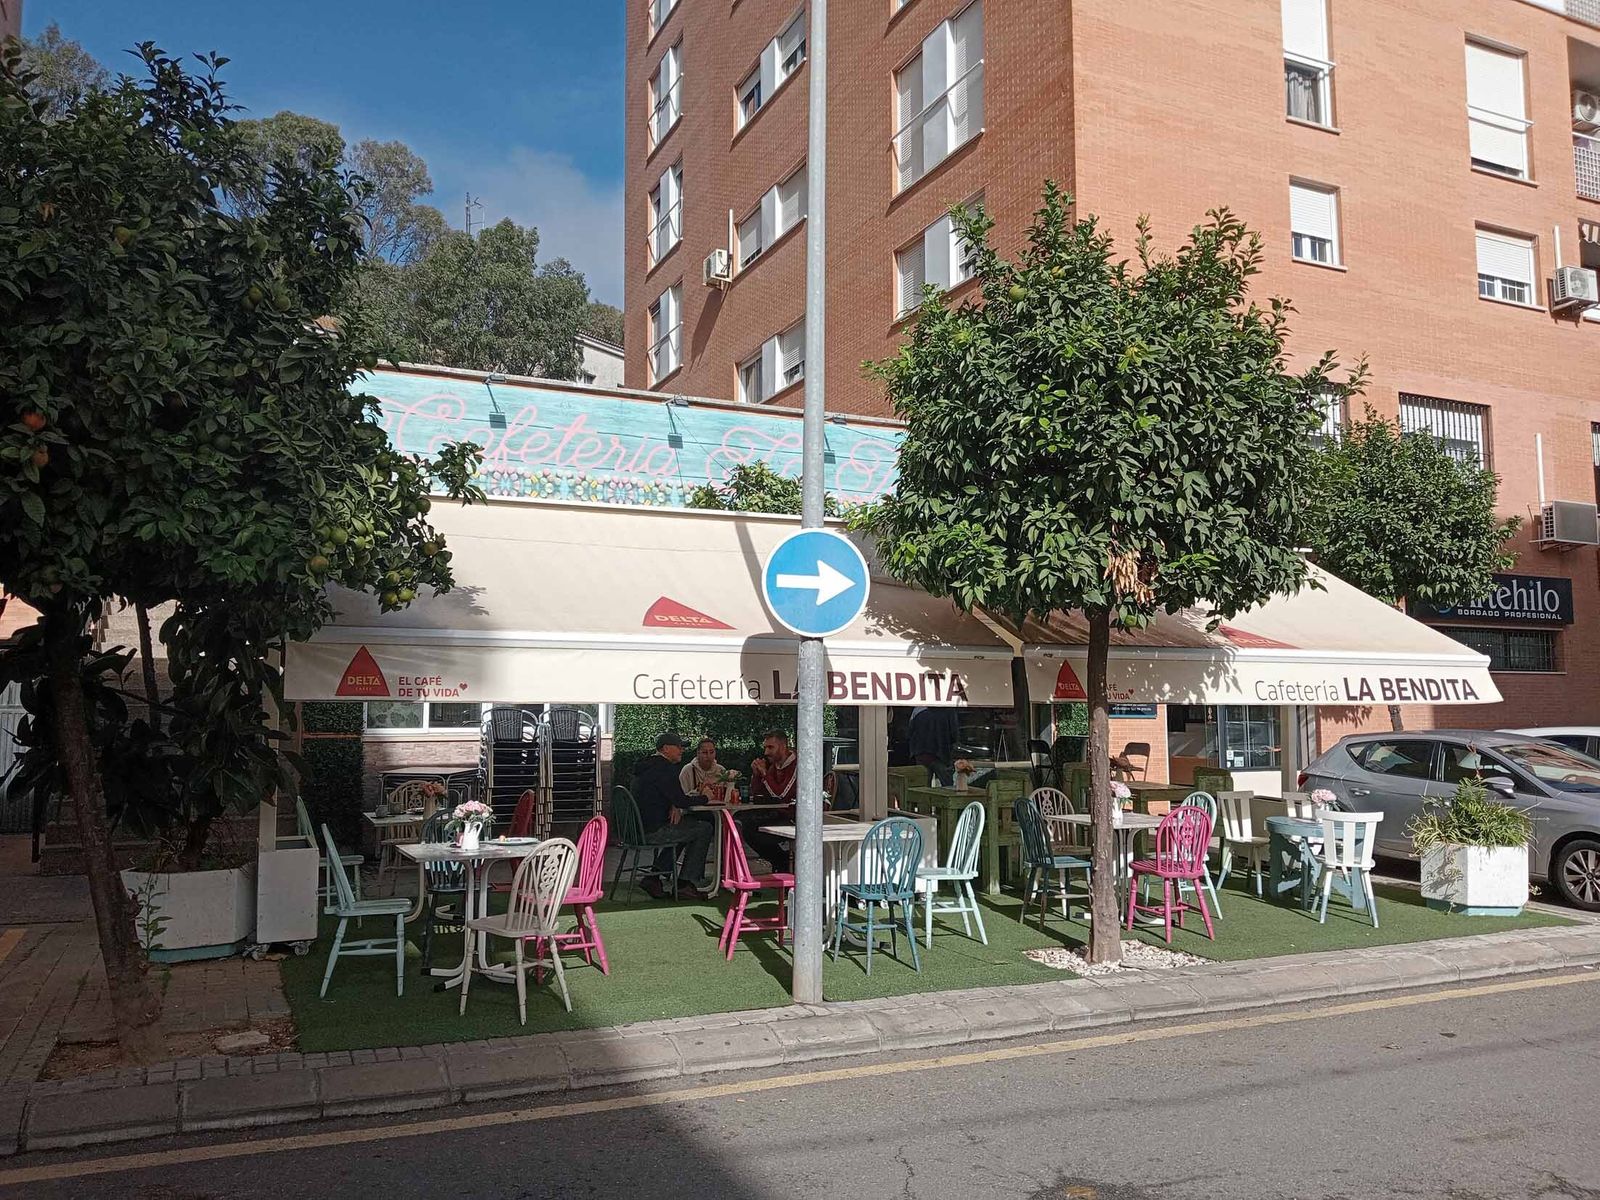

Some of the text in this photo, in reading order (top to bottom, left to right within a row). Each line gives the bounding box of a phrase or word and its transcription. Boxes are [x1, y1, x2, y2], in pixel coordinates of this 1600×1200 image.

[654, 614, 713, 624] DELTA
[1457, 608, 1563, 620] BORDADO PROFESIONAL
[347, 675, 380, 686] DELTA
[398, 675, 442, 686] EL CAFÉ
[633, 670, 969, 702] Cafetería L BENDITA
[1058, 682, 1080, 691] DELTA
[1254, 677, 1480, 702] Cafetería LA BENDITA
[398, 688, 460, 697] DE TU VIDA
[1112, 692, 1130, 700] VIDA
